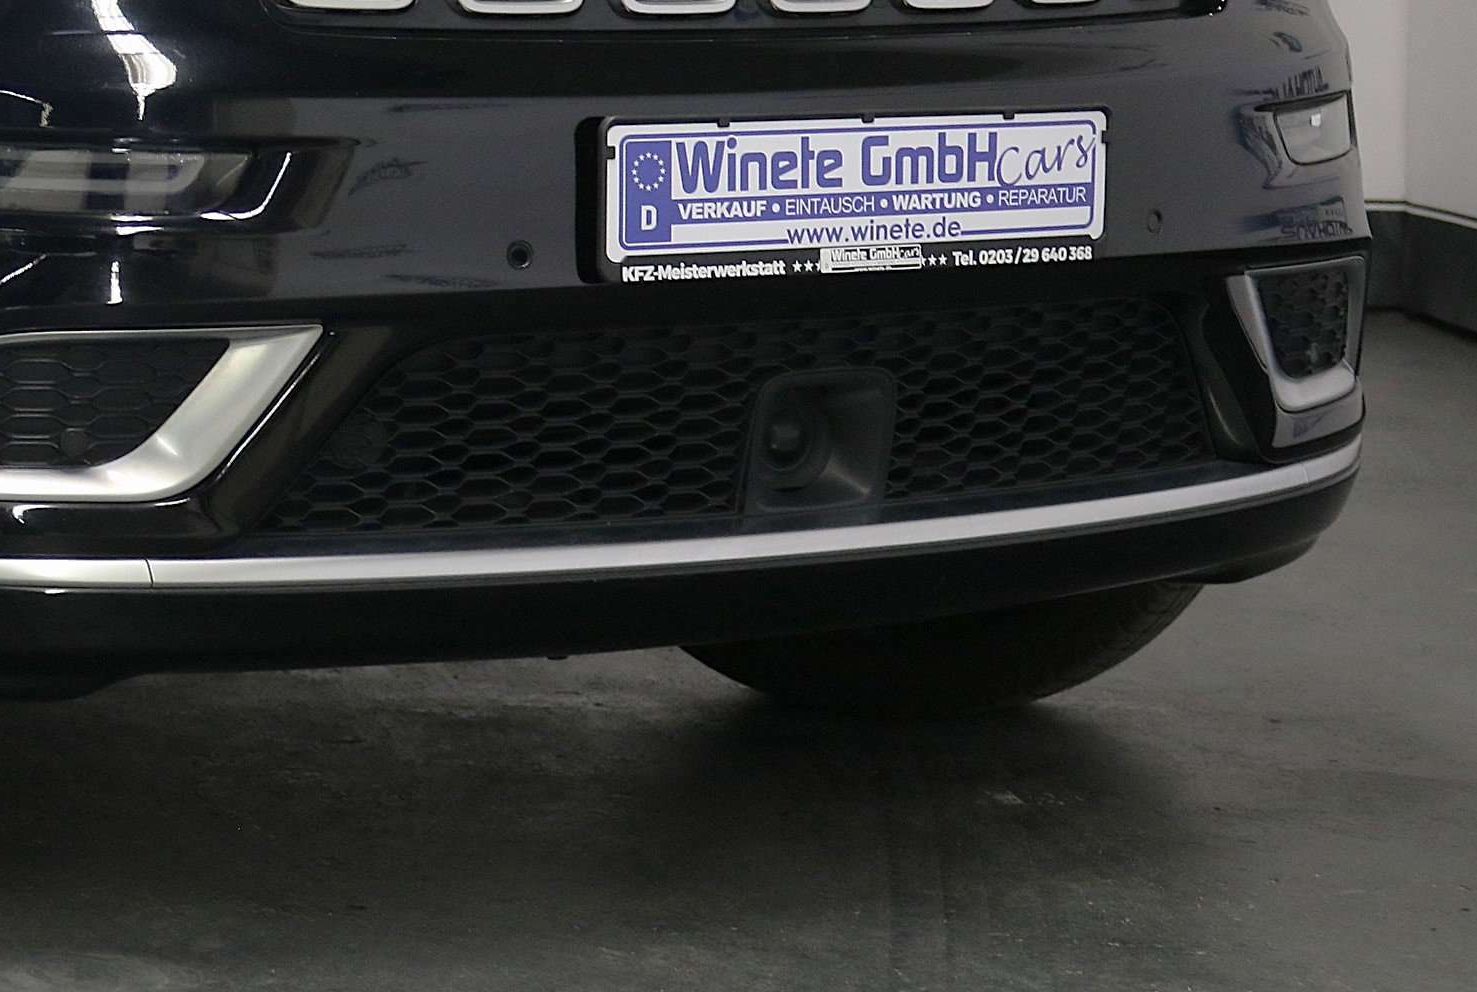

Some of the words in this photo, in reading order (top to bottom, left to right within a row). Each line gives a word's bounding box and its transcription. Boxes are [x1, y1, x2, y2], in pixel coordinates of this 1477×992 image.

[675, 136, 843, 194] Winete
[861, 131, 998, 186] GmbH
[678, 200, 768, 221] VERKAUF
[785, 195, 875, 216] EINTAUSCH
[892, 190, 981, 210] WARTUNG
[998, 187, 1087, 207] REPARATUR
[640, 205, 658, 231] D
[786, 216, 963, 245] www.winete.de
[952, 249, 977, 266] Tel.
[1041, 246, 1068, 263] 640
[1069, 245, 1093, 261] 368
[622, 259, 786, 283] KFZ-Meisterwerkstatt
